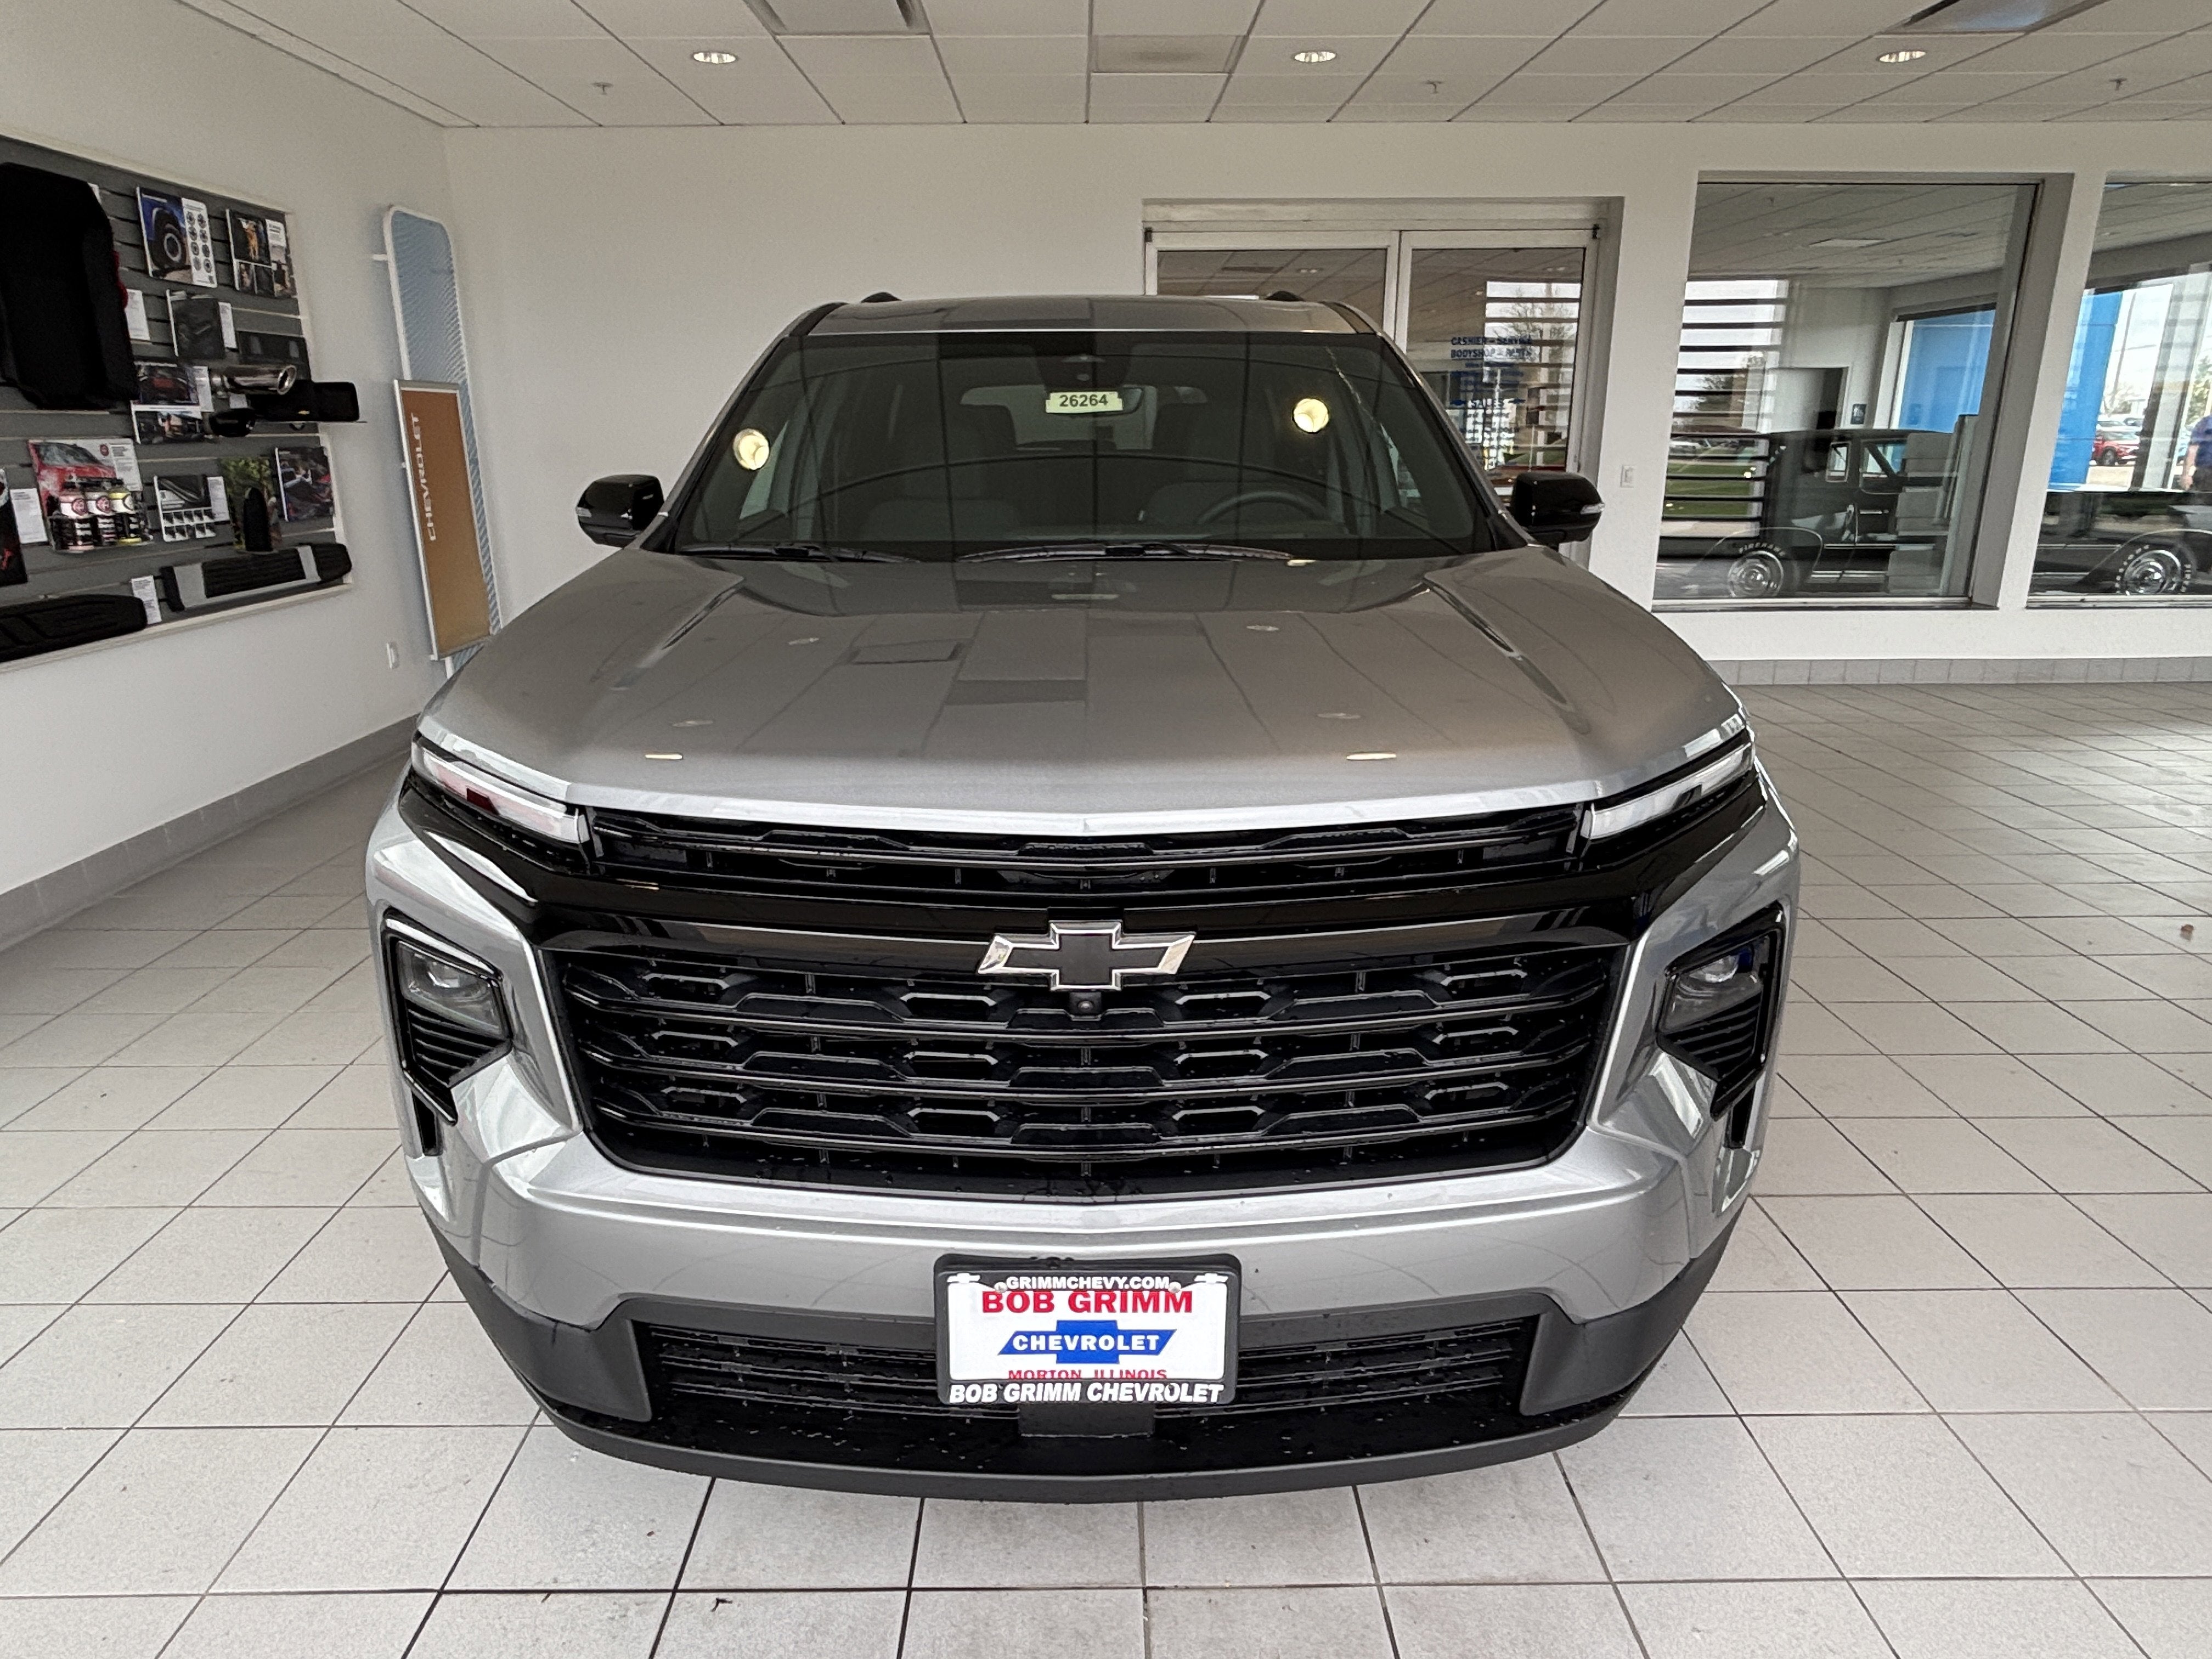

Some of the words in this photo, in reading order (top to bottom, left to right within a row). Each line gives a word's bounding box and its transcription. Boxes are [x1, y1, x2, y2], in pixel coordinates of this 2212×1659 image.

[1451, 349, 1496, 358] BODYSHOP
[1059, 393, 1108, 407] 26264
[410, 412, 437, 541] CHEVROLET
[1005, 1276, 1170, 1290] GRIMMCHEVY.COM
[982, 1290, 1054, 1313] BOB
[1068, 1290, 1193, 1313] GRIMM
[1012, 1334, 1160, 1351] CHEVROLET
[949, 1383, 998, 1403] BOB
[1003, 1382, 1082, 1402] GRIMM
[1086, 1381, 1224, 1403] CHEVROLET
